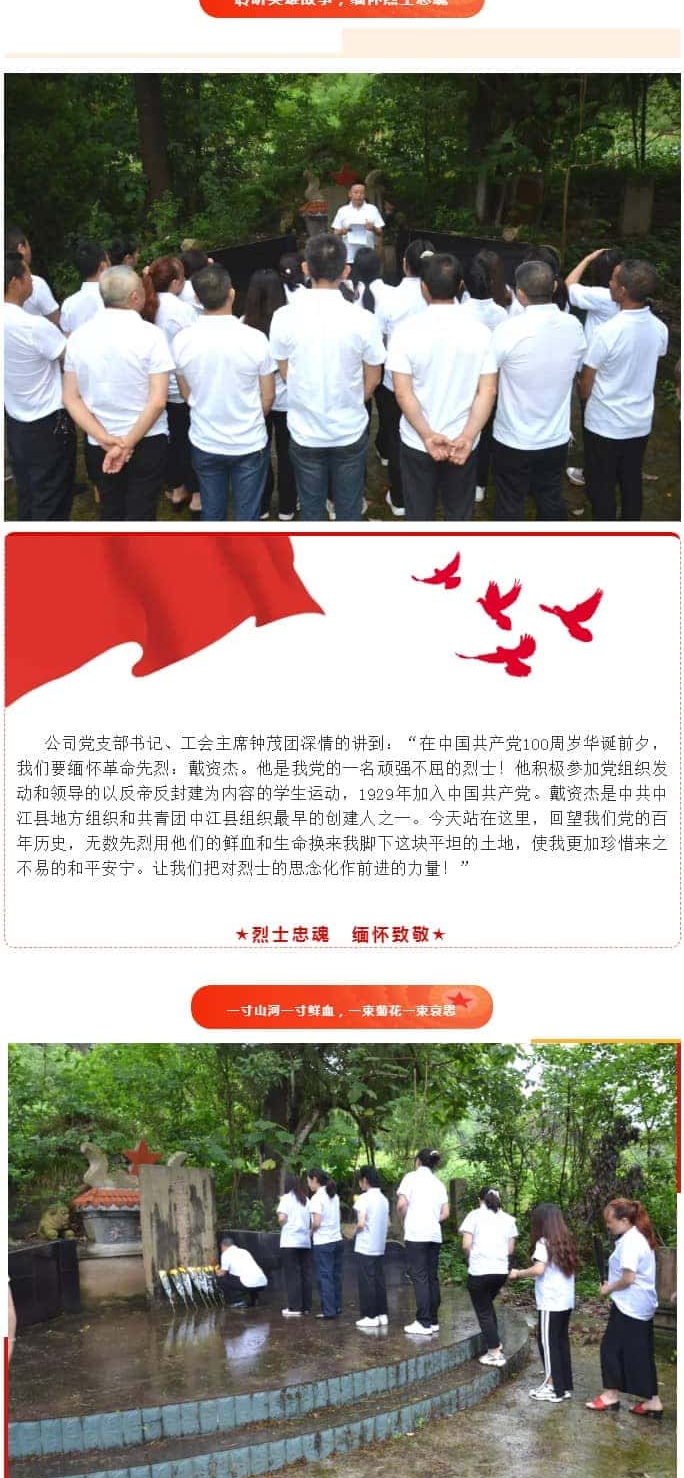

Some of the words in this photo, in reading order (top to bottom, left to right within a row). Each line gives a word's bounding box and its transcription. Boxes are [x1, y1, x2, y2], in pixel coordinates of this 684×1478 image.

[252, 926, 329, 943] 烈士忠魂
[351, 926, 429, 943] 缅怀致敬
